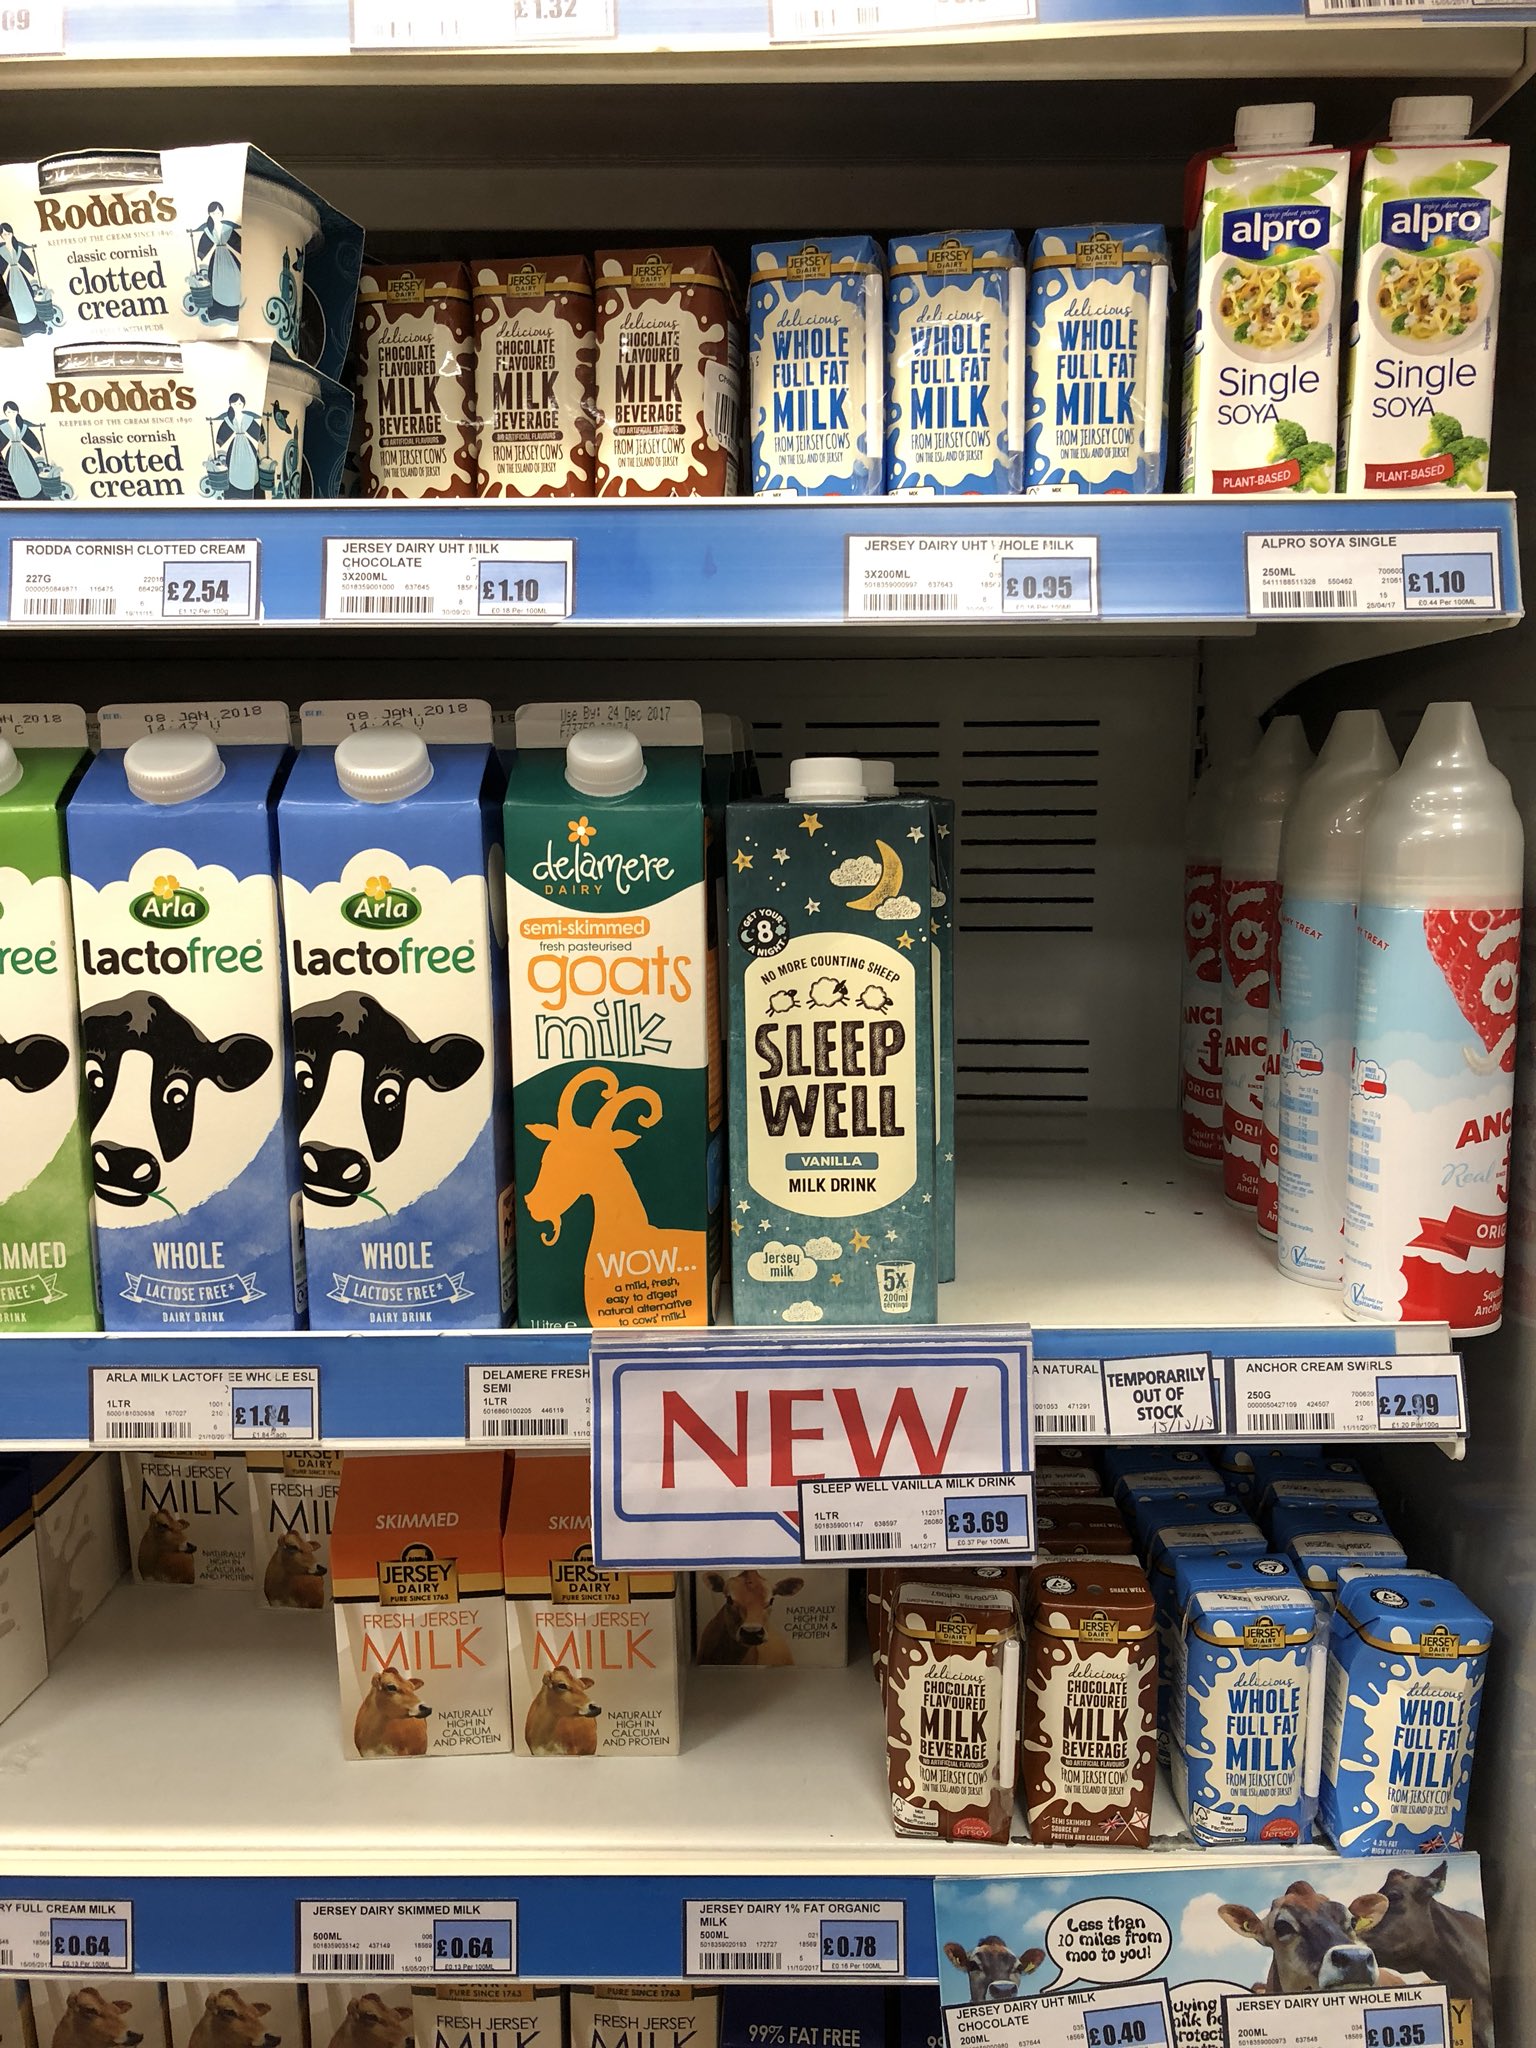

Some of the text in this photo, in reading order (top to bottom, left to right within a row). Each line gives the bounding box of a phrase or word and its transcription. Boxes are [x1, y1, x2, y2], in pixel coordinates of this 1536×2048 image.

[34, 190, 177, 232] Rodda's
[1231, 211, 1322, 251] alpro
[67, 245, 158, 264] classic cornish
[69, 261, 166, 296] clotted
[77, 295, 169, 321] cream
[620, 313, 679, 331] delicious
[619, 330, 680, 348] CHOCOLATE
[1058, 319, 1137, 351] WHOLE
[618, 346, 680, 363] FLAVOURED
[1057, 353, 1137, 380] FULL FAT
[615, 363, 683, 403] MILK
[1218, 365, 1319, 402] Single
[1056, 381, 1137, 426] MILK
[615, 402, 682, 424] BEVERAGE
[1217, 404, 1279, 425] SOYA
[1222, 469, 1291, 489] PLANT-BASED
[26, 544, 246, 555] RODDA CORNISH CLOTTED CREAM
[1261, 536, 1397, 549] ALPRO SOYA SINGLE
[26, 574, 51, 583] 227G
[1262, 567, 1296, 576] 250ML
[560, 708, 577, 725] Use
[608, 706, 619, 719] 24
[625, 706, 641, 721] Dec
[647, 706, 671, 721] 2017
[532, 839, 675, 895] delamere
[545, 884, 603, 895] DAIRY
[142, 897, 196, 918] Arla
[354, 897, 408, 918] Arla
[743, 909, 784, 928] GET YOUR
[523, 920, 645, 936] semi-skimmed
[757, 920, 774, 943] 8
[82, 936, 263, 975] lactofree
[293, 937, 476, 975] lactofree
[539, 942, 632, 953] fresh pasteurised
[757, 939, 786, 957] NIGHT
[527, 945, 692, 1011] goats
[760, 955, 901, 985] NO MORE COUNTING SHEEP
[535, 998, 672, 1060] milk
[755, 1020, 906, 1080] SLEEP
[759, 1082, 905, 1138] WELL
[801, 1156, 862, 1167] VANILLA
[789, 1177, 876, 1192] MILK DRINK
[153, 1241, 225, 1269] WHOLE
[597, 1247, 697, 1278] WOW...
[763, 1252, 800, 1265] Jersey
[770, 1265, 794, 1277] milk
[615, 1277, 680, 1292] a mild, fresh,
[606, 1289, 678, 1305] easy to digest
[598, 1299, 692, 1317] natural alternative
[162, 1312, 225, 1323] DAIRY DRINK
[619, 1317, 629, 1327] to
[483, 1369, 590, 1380] DELAMERE FRESH
[1043, 1364, 1098, 1375] NATURAL
[1246, 1361, 1392, 1373] ANCHOR CREAM SWIRLS
[1107, 1367, 1206, 1388] TEMPORARILY
[483, 1384, 511, 1393] SEMI
[1133, 1387, 1184, 1403] OUT OF
[1247, 1391, 1271, 1400] 250G
[1137, 1405, 1184, 1421] STOCK
[661, 1386, 968, 1489] NEW
[813, 1476, 1016, 1494] SLEEP WELL VANILLA MILK DRINK
[375, 1512, 459, 1530] SKIMMED
[814, 1512, 839, 1521] 1LTR
[382, 1564, 452, 1584] JERSEY
[397, 1582, 439, 1594] DAIRY
[1129, 1586, 1146, 1594] WELL
[364, 1610, 480, 1629] FRESH JERSEY
[361, 1626, 486, 1672] MILK
[1067, 1679, 1127, 1695] CHOCOLATE
[1067, 1694, 1127, 1709] FLAVOURED
[1227, 1687, 1300, 1713] WHOLE
[1062, 1707, 1129, 1743] MILK
[1227, 1714, 1298, 1735] FULL FAT
[1062, 1742, 1127, 1759] BEVERAGE
[1226, 1737, 1297, 1771] MILK
[16, 1904, 116, 1914] FULL CREAM MILK
[313, 1905, 480, 1916] JERSEY DAIRY SKIMMED MILK
[700, 1904, 881, 1914] JERSEY DAIRY 1% FAT ORGANIC
[700, 1917, 727, 1927] MILK
[1067, 1915, 1146, 1932] Less than
[313, 1932, 342, 1940] 500ML
[700, 1931, 729, 1939] 500ML
[1058, 1930, 1162, 1947] 10 miles from
[1066, 1946, 1152, 1963] moo to you!
[1236, 1991, 1422, 2012] JERSEY DAIRY UHT WHOLE MILK
[749, 2025, 861, 2047] 99% FAT FREE
[1238, 2028, 1268, 2037] 200ML
